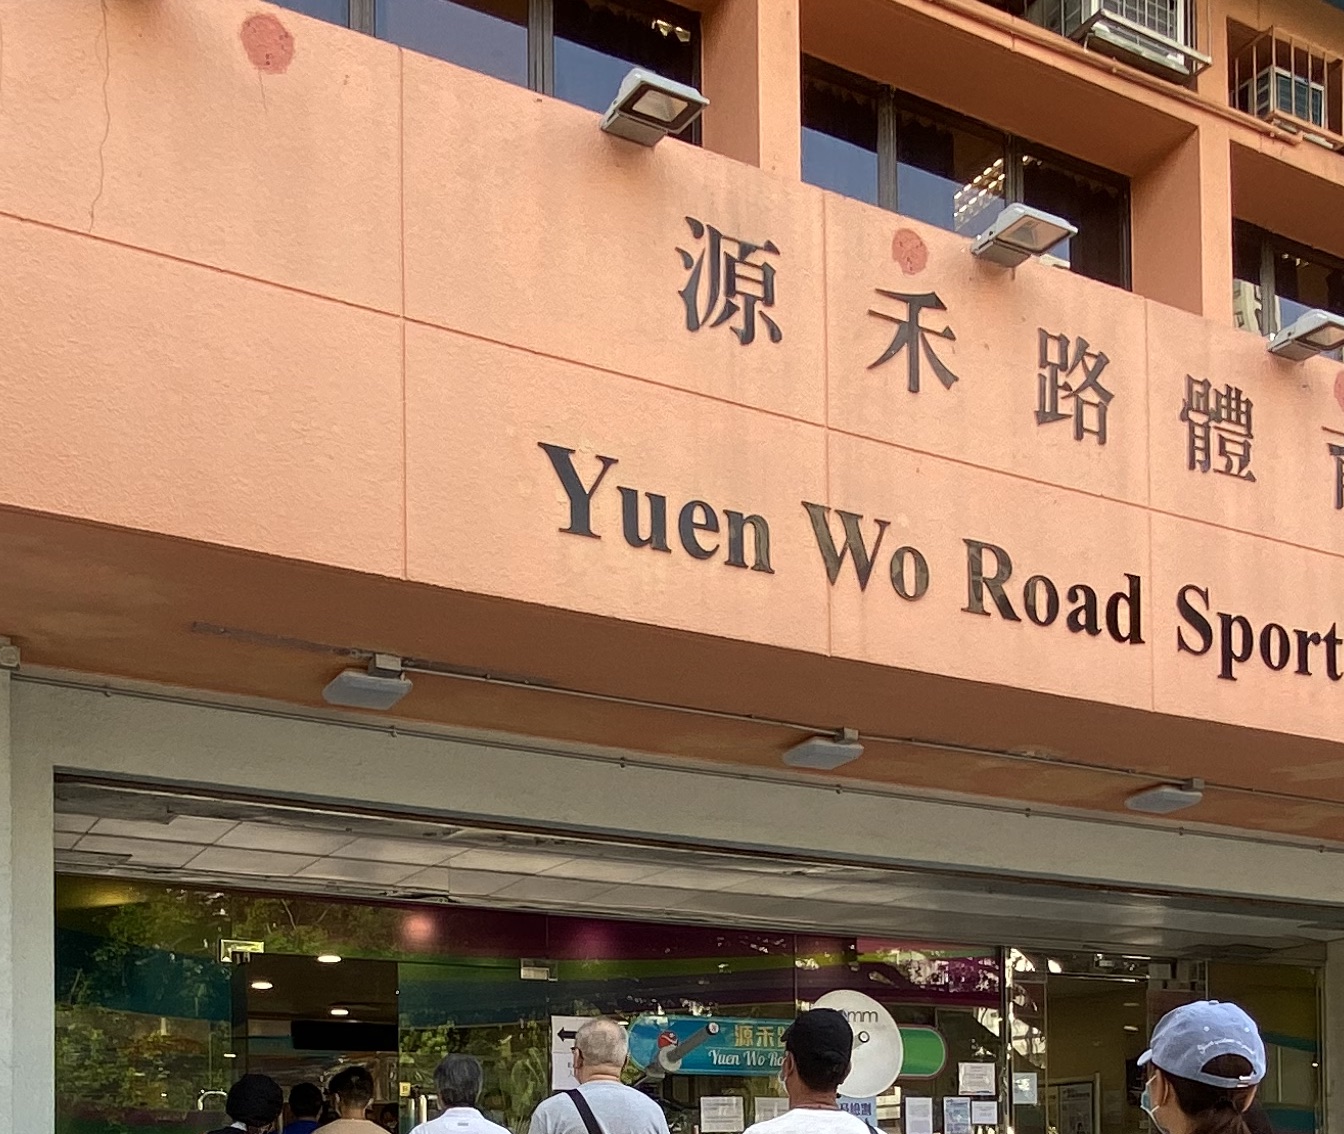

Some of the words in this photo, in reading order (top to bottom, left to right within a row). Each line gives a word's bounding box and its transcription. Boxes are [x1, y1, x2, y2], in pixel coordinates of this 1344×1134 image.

[537, 441, 775, 576] Yuen
[801, 500, 930, 602] Wo
[960, 537, 1146, 646] Road
[841, 1010, 879, 1023] mm
[707, 1049, 740, 1067] Yuen
[742, 1050, 766, 1067] Wo
[767, 1051, 785, 1068] Ro
